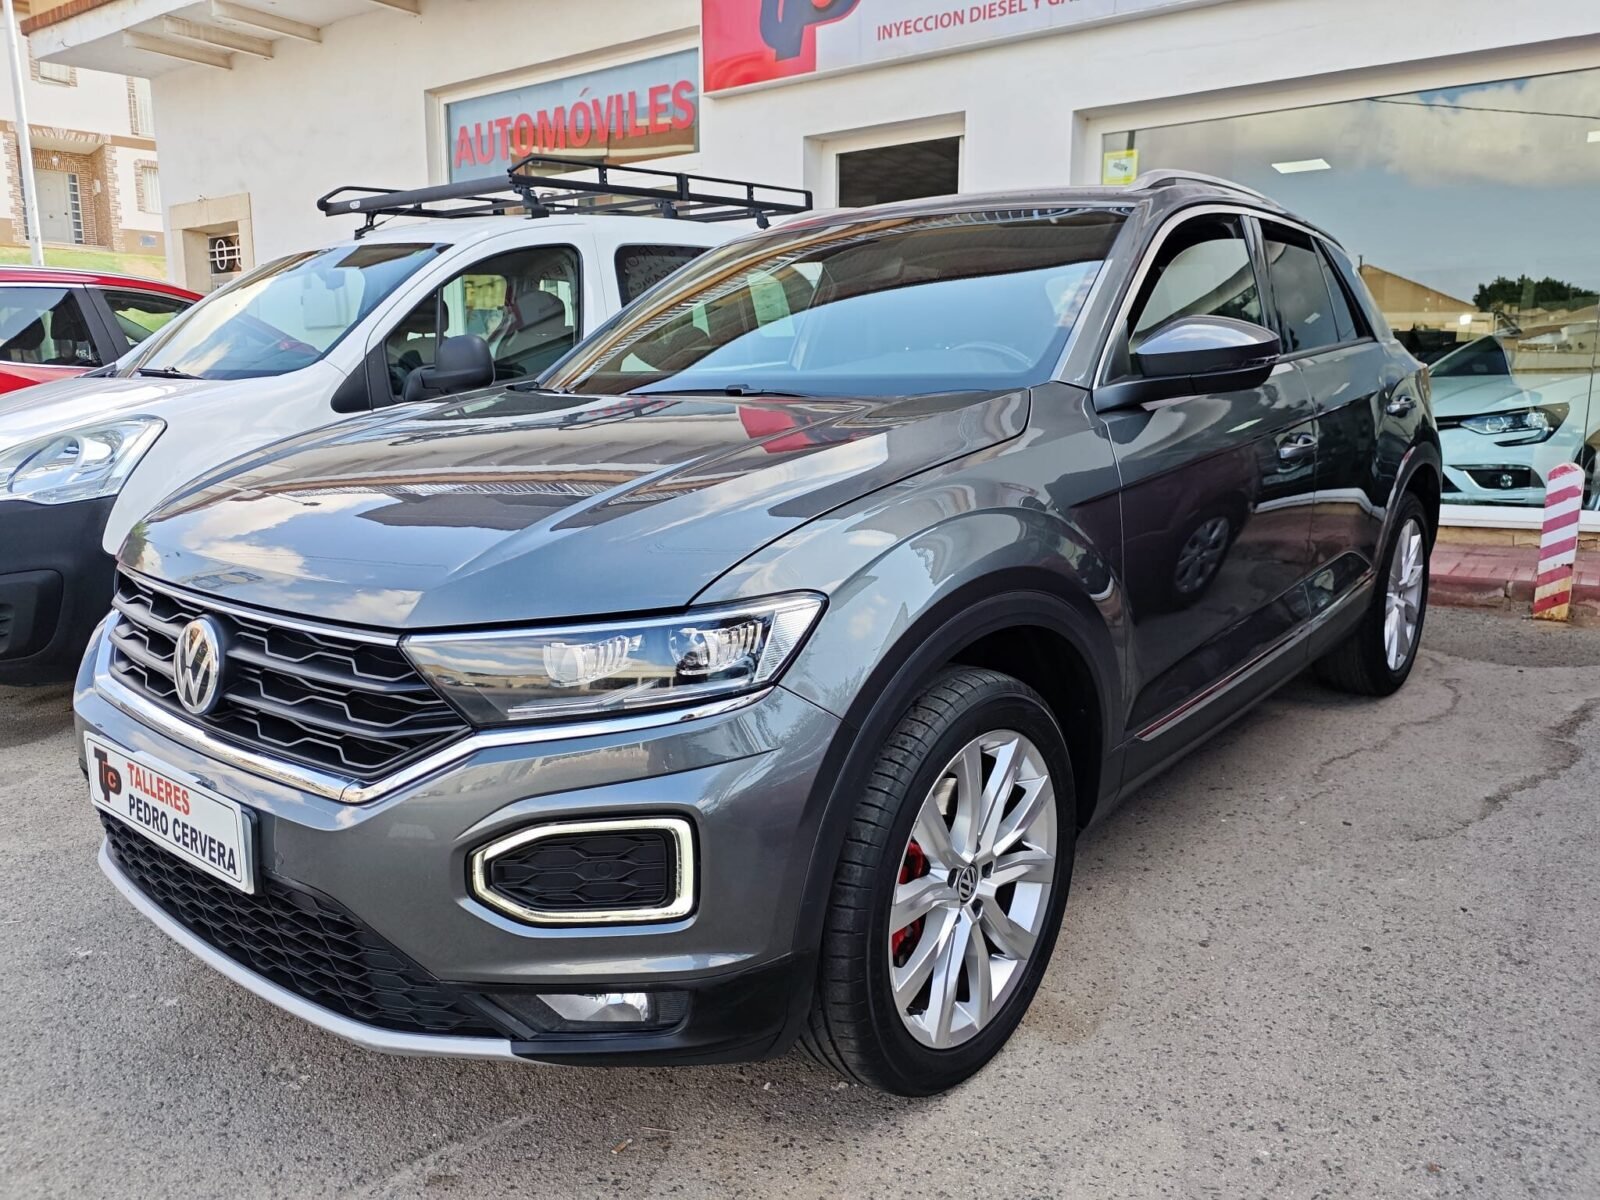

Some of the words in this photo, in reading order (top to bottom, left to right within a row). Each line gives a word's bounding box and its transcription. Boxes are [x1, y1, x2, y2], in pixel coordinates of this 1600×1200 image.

[877, 9, 965, 41] INYECCION
[969, 0, 1028, 23] DIESEL
[453, 79, 697, 169] AUTOMÓVILES
[127, 762, 190, 816] TALLERES
[128, 793, 169, 836] PEDRO
[172, 817, 237, 875] CERVERA
